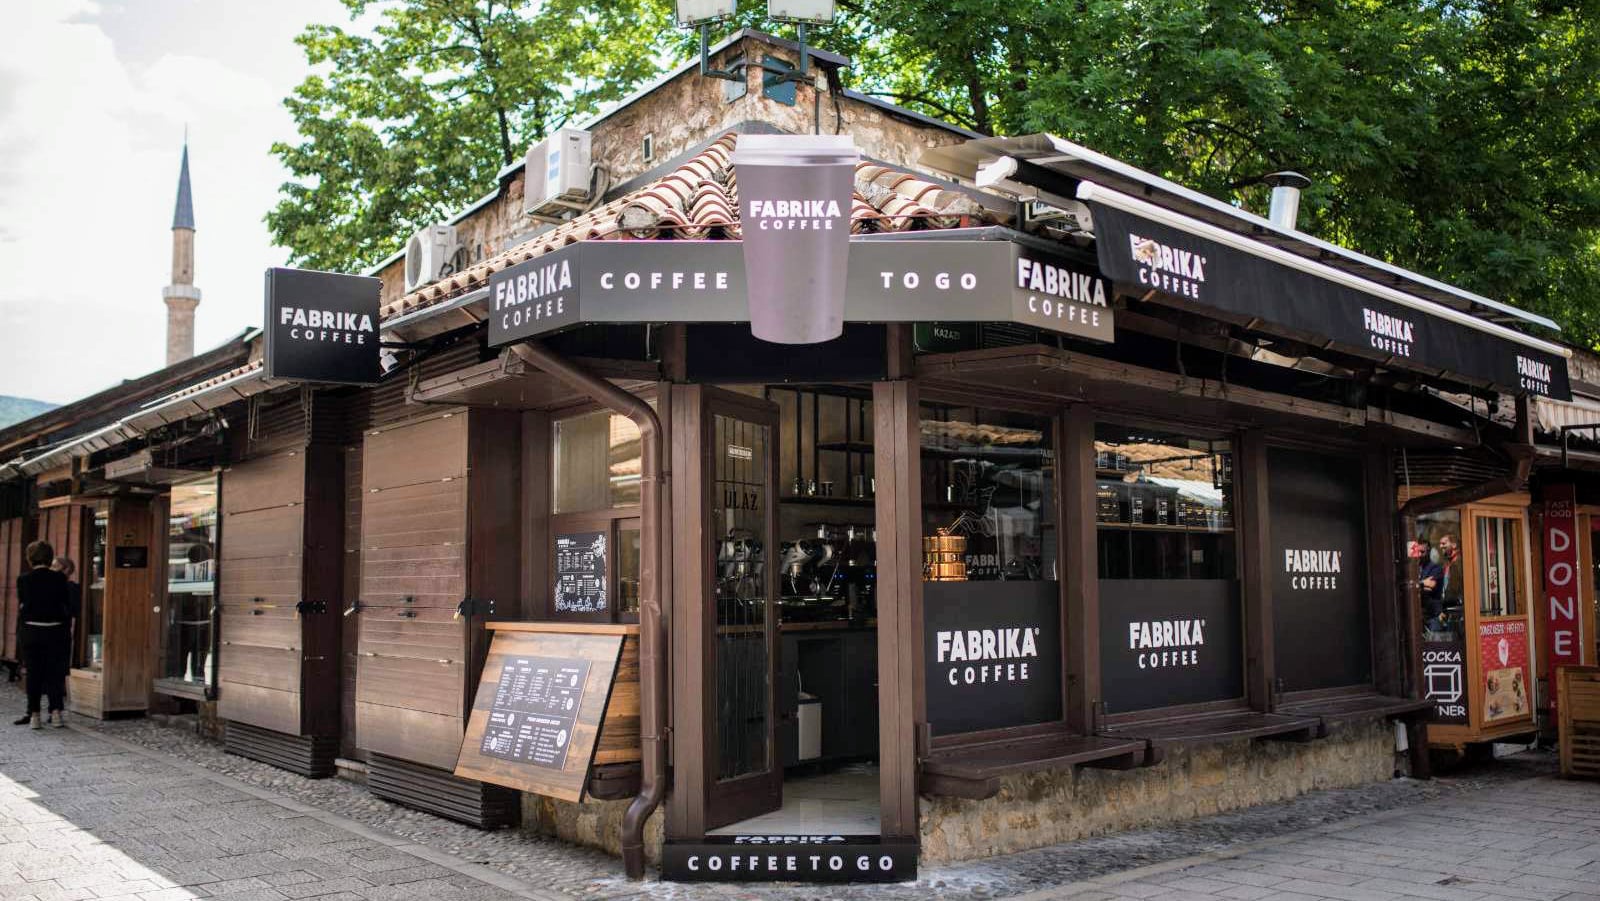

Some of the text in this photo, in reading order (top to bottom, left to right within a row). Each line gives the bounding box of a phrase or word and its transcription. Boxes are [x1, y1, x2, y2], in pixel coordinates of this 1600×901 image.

[750, 200, 841, 218] FABRIKA
[759, 219, 833, 230] COFFEE
[494, 259, 572, 311] FABRIKA
[600, 271, 977, 290] COFFEE TO GO
[1017, 257, 1107, 308] FABRIKA
[1139, 267, 1199, 299] COFFEE
[280, 306, 374, 332] FABRIKA
[503, 295, 564, 330] COFFEE
[1029, 296, 1100, 327] COFFEE
[290, 328, 365, 345] COFFEE
[1363, 307, 1413, 343] FABRIKA
[1370, 333, 1410, 357] COFFEE
[1517, 355, 1551, 383] FABRIKA
[1285, 549, 1341, 573] FABRIKA
[1292, 576, 1337, 590] COFFEE
[936, 627, 1038, 663] FABRIKA
[1129, 620, 1204, 650] FABRIKA
[1138, 650, 1198, 669] COFFEE
[949, 662, 1029, 686] COFFEE
[1436, 705, 1466, 717] NER
[687, 855, 893, 871] COFFEE TO GO
